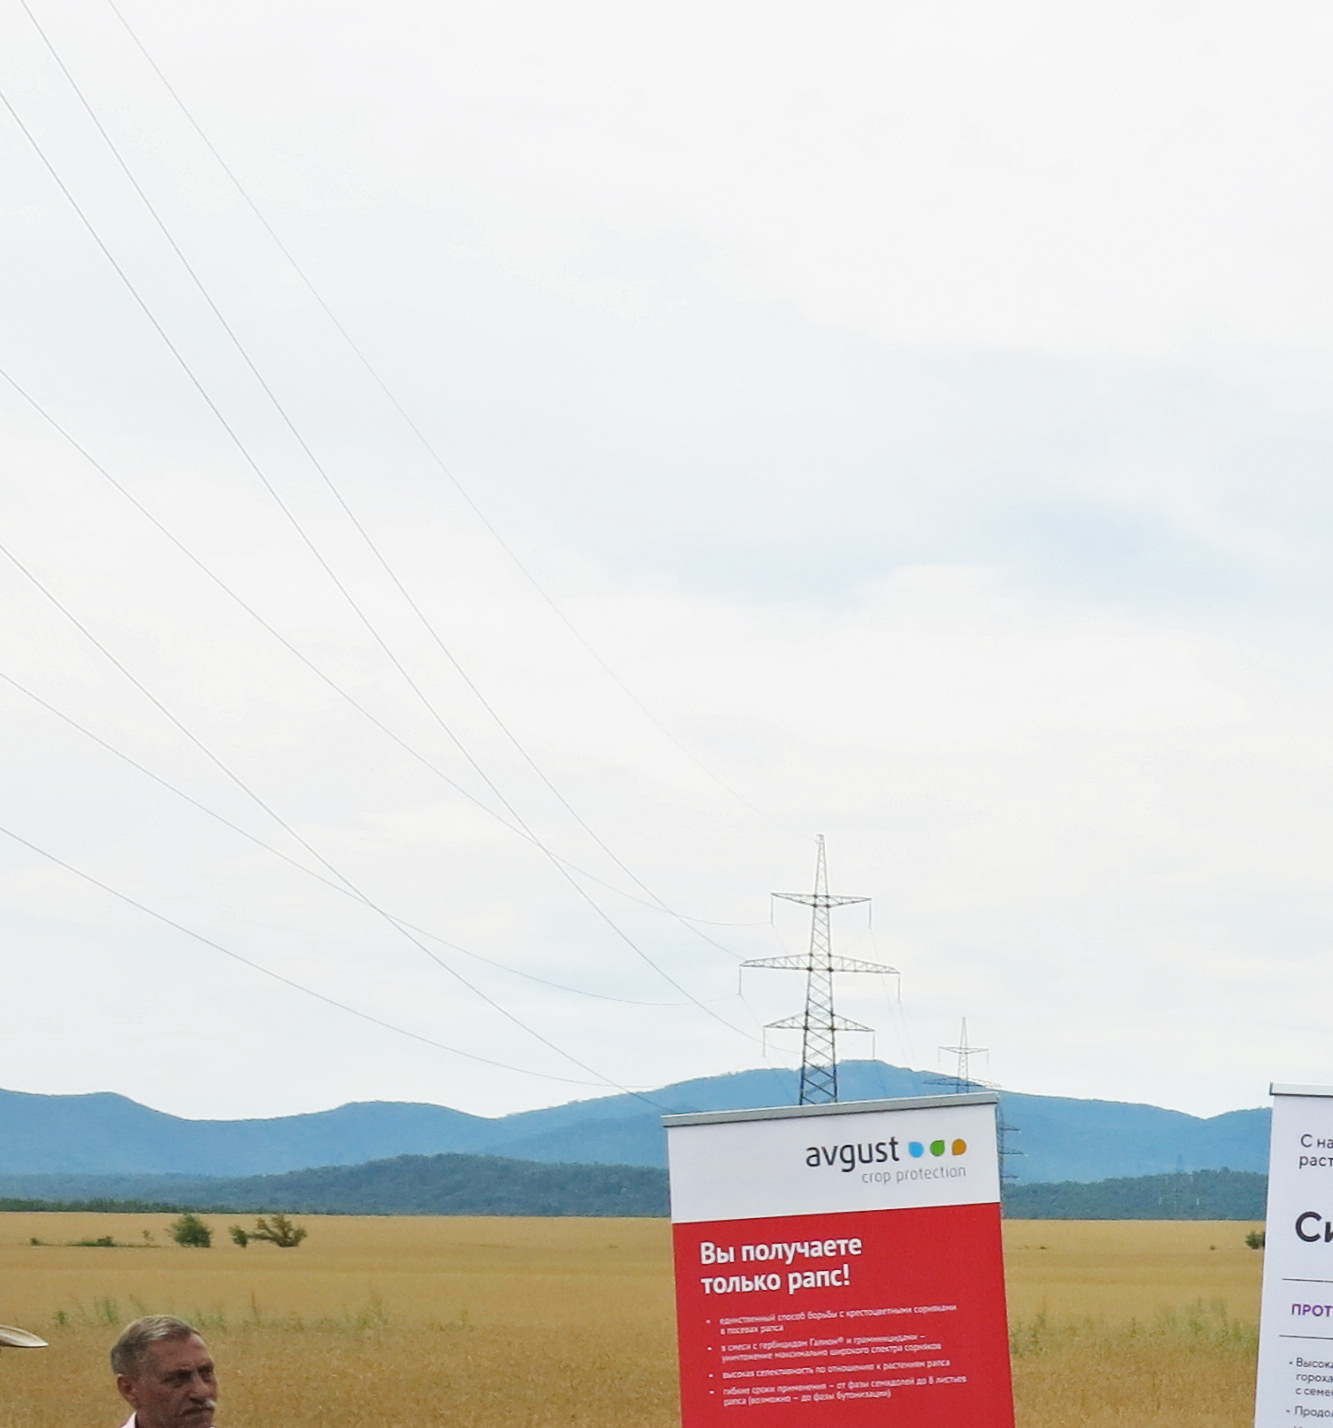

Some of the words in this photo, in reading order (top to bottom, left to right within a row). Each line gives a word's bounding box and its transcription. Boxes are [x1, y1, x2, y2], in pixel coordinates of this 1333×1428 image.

[806, 1136, 900, 1171] avgust
[1300, 1134, 1312, 1150] С
[862, 1169, 891, 1184] crop
[896, 1166, 967, 1182] protection
[700, 1240, 735, 1265] Вы
[741, 1237, 862, 1265] получаете
[700, 1271, 781, 1295] только
[788, 1263, 850, 1295] рапс!
